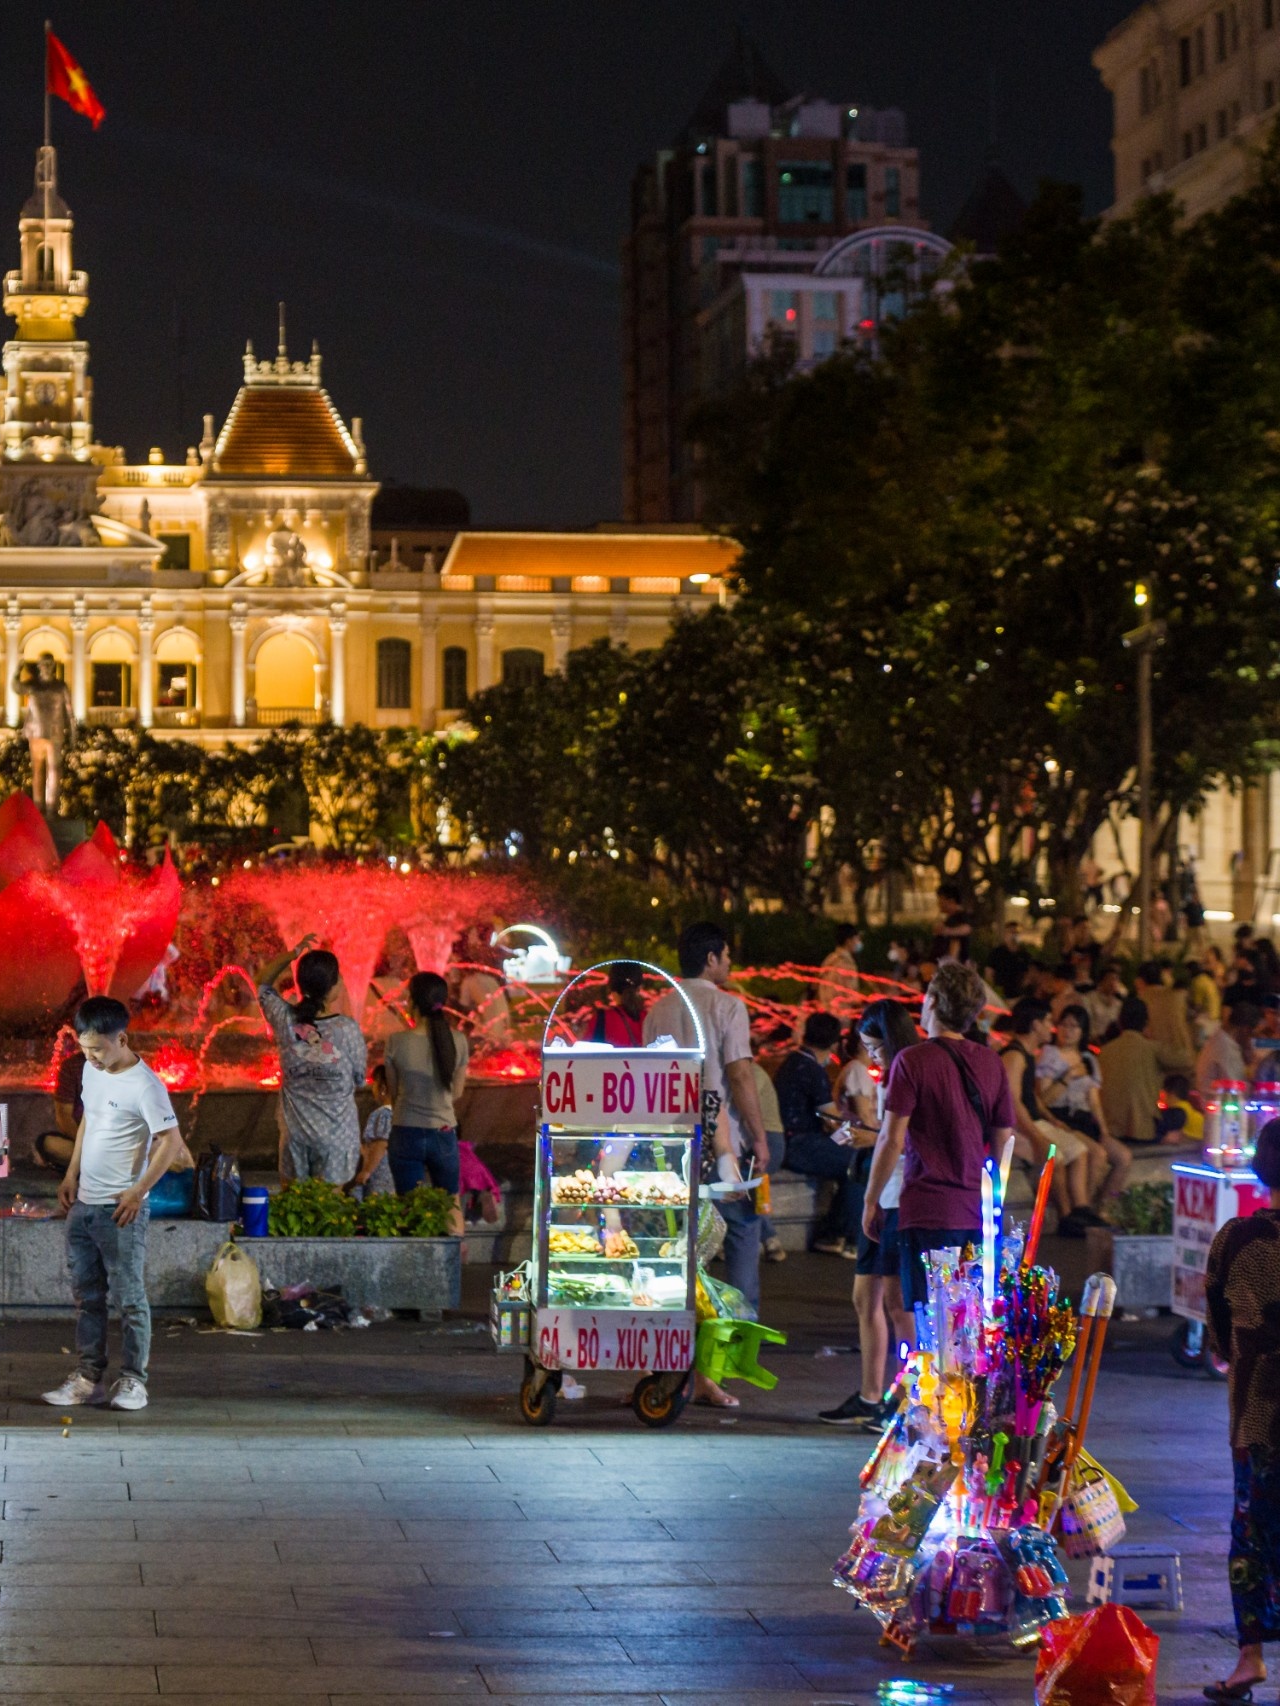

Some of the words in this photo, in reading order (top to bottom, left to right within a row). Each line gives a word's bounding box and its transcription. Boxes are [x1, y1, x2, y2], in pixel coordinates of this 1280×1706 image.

[545, 1061, 577, 1114] CÁ
[602, 1061, 635, 1114] BÒ
[644, 1062, 700, 1114] VIÊN
[1176, 1176, 1218, 1223] KEM
[540, 1316, 561, 1369] CÁ
[577, 1316, 600, 1369] BÒ
[616, 1317, 648, 1370] XÚC
[653, 1317, 690, 1370] XÍCH
